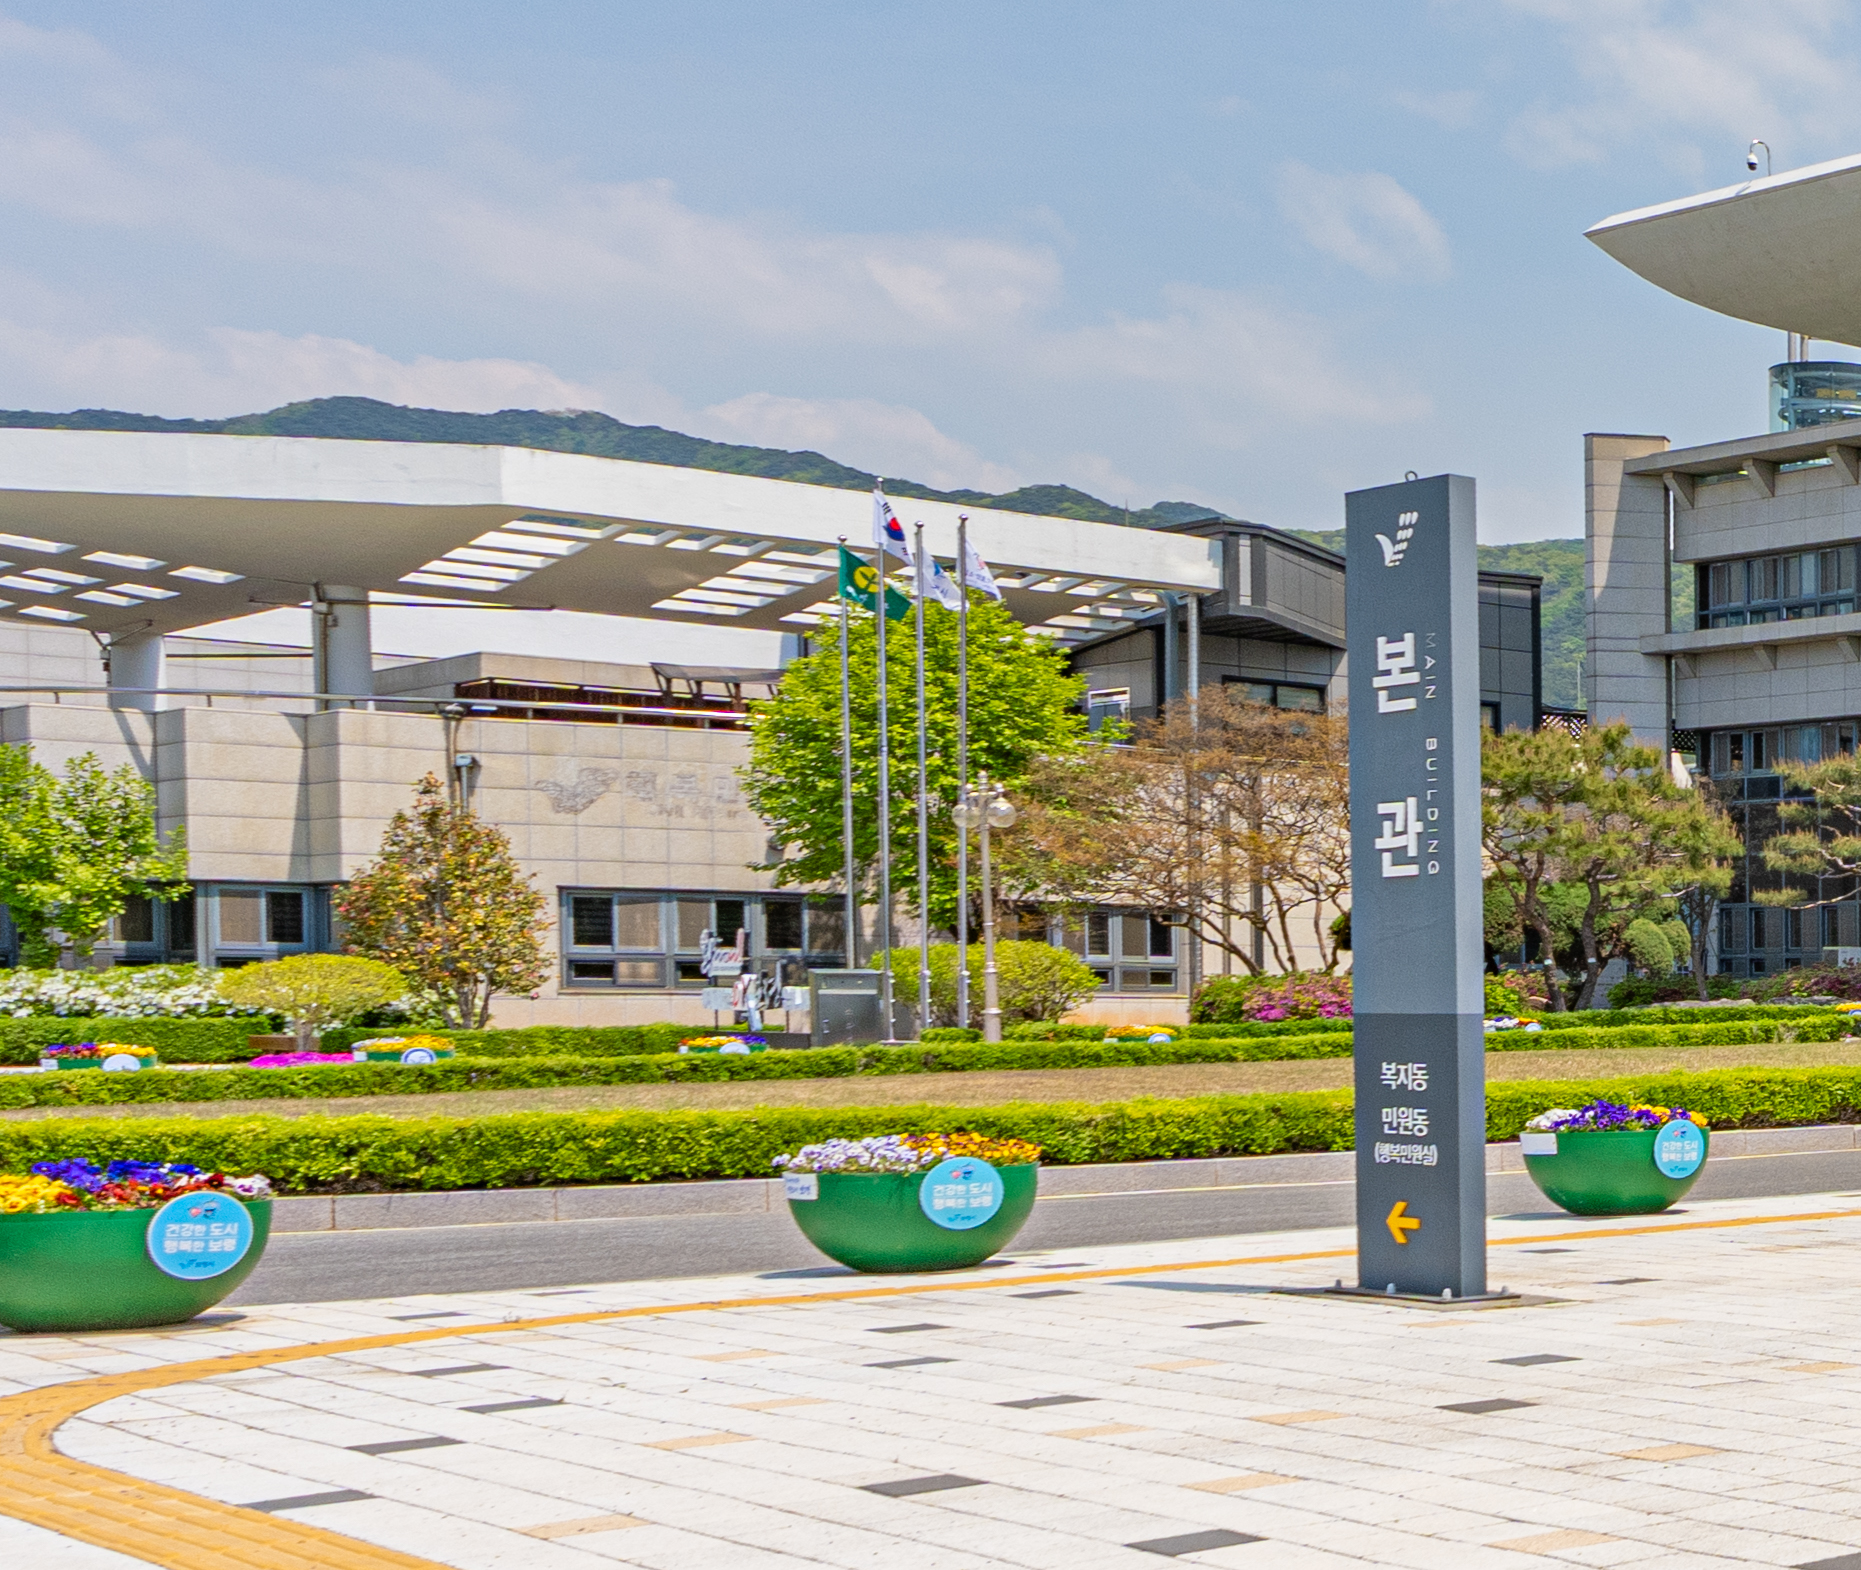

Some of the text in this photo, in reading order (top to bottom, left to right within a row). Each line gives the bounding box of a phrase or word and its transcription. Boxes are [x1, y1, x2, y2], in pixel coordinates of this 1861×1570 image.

[1424, 632, 1440, 875] MAIN BUILDING
[1380, 1062, 1429, 1091] 복지동
[1381, 1107, 1430, 1136] 민원동
[1374, 1142, 1438, 1166] (행복민원실)
[165, 1222, 239, 1237] 건강한 도시
